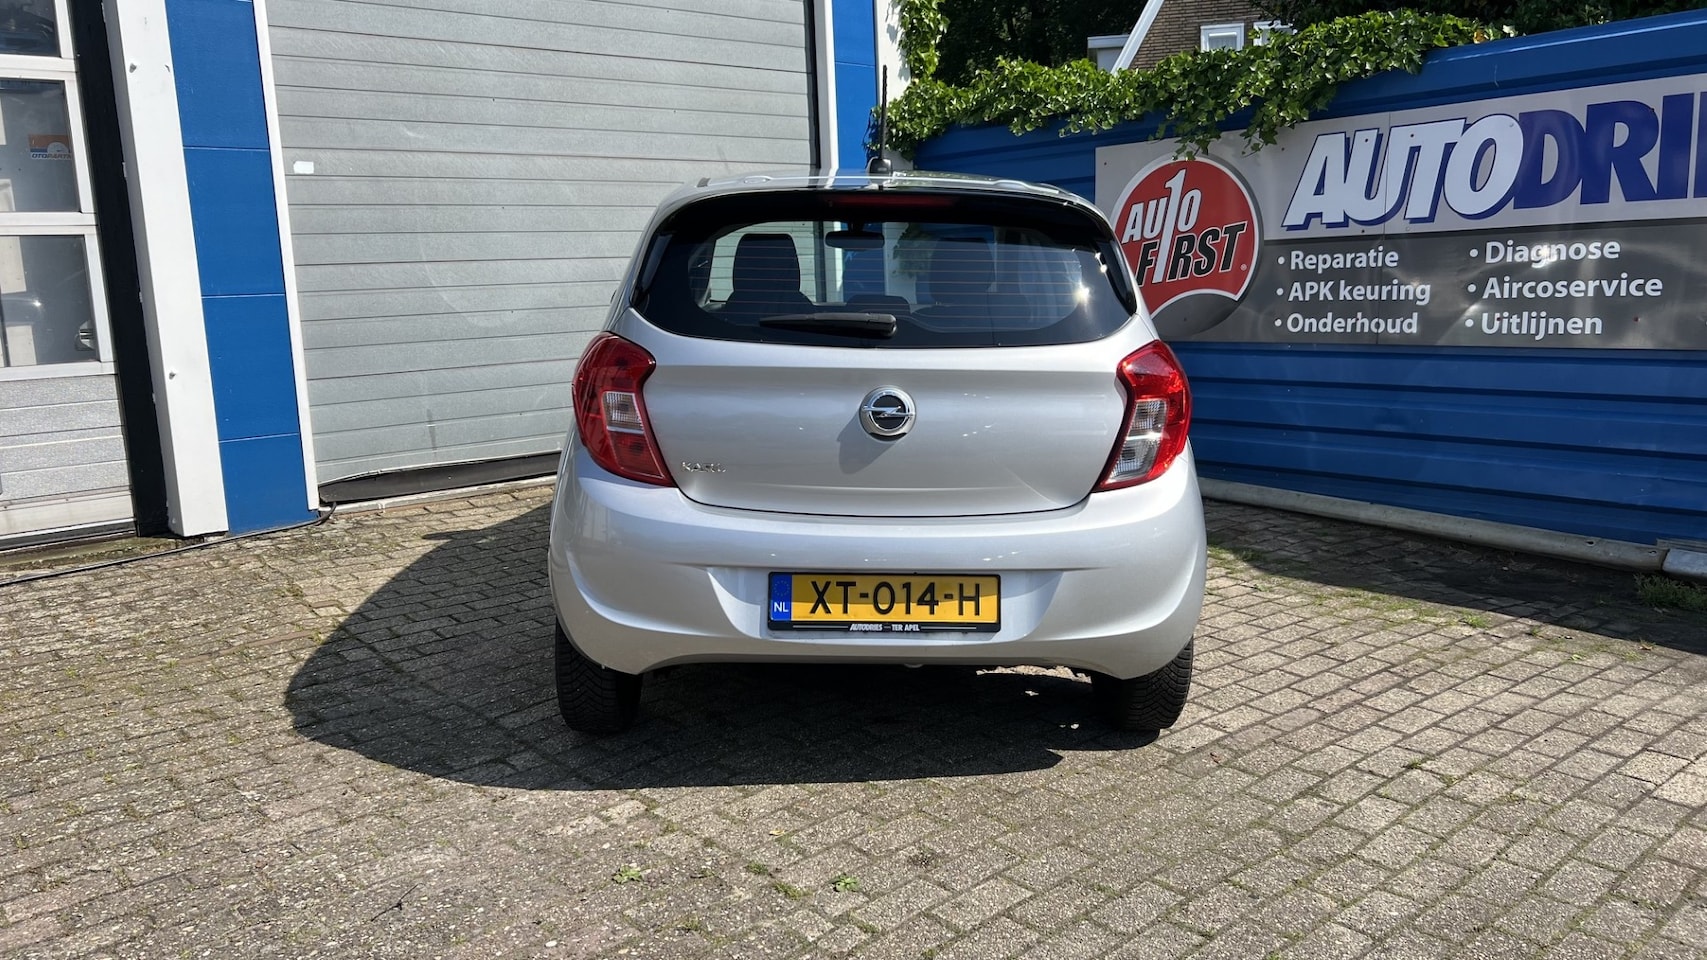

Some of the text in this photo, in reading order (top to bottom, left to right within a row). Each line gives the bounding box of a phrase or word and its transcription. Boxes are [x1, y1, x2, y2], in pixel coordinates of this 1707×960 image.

[1281, 91, 1707, 231] AUTODRI
[1290, 246, 1399, 274] Reparatie
[1485, 240, 1621, 268] Diagnose
[1288, 279, 1431, 306] APK keuring
[1482, 272, 1663, 299] Aircoservice
[1286, 312, 1419, 334] Onderhoud
[1481, 311, 1603, 341] Uitlijnen
[774, 580, 980, 616] NL XT-014-H
[850, 623, 883, 631] AUTODRIES
[891, 623, 903, 631] TER
